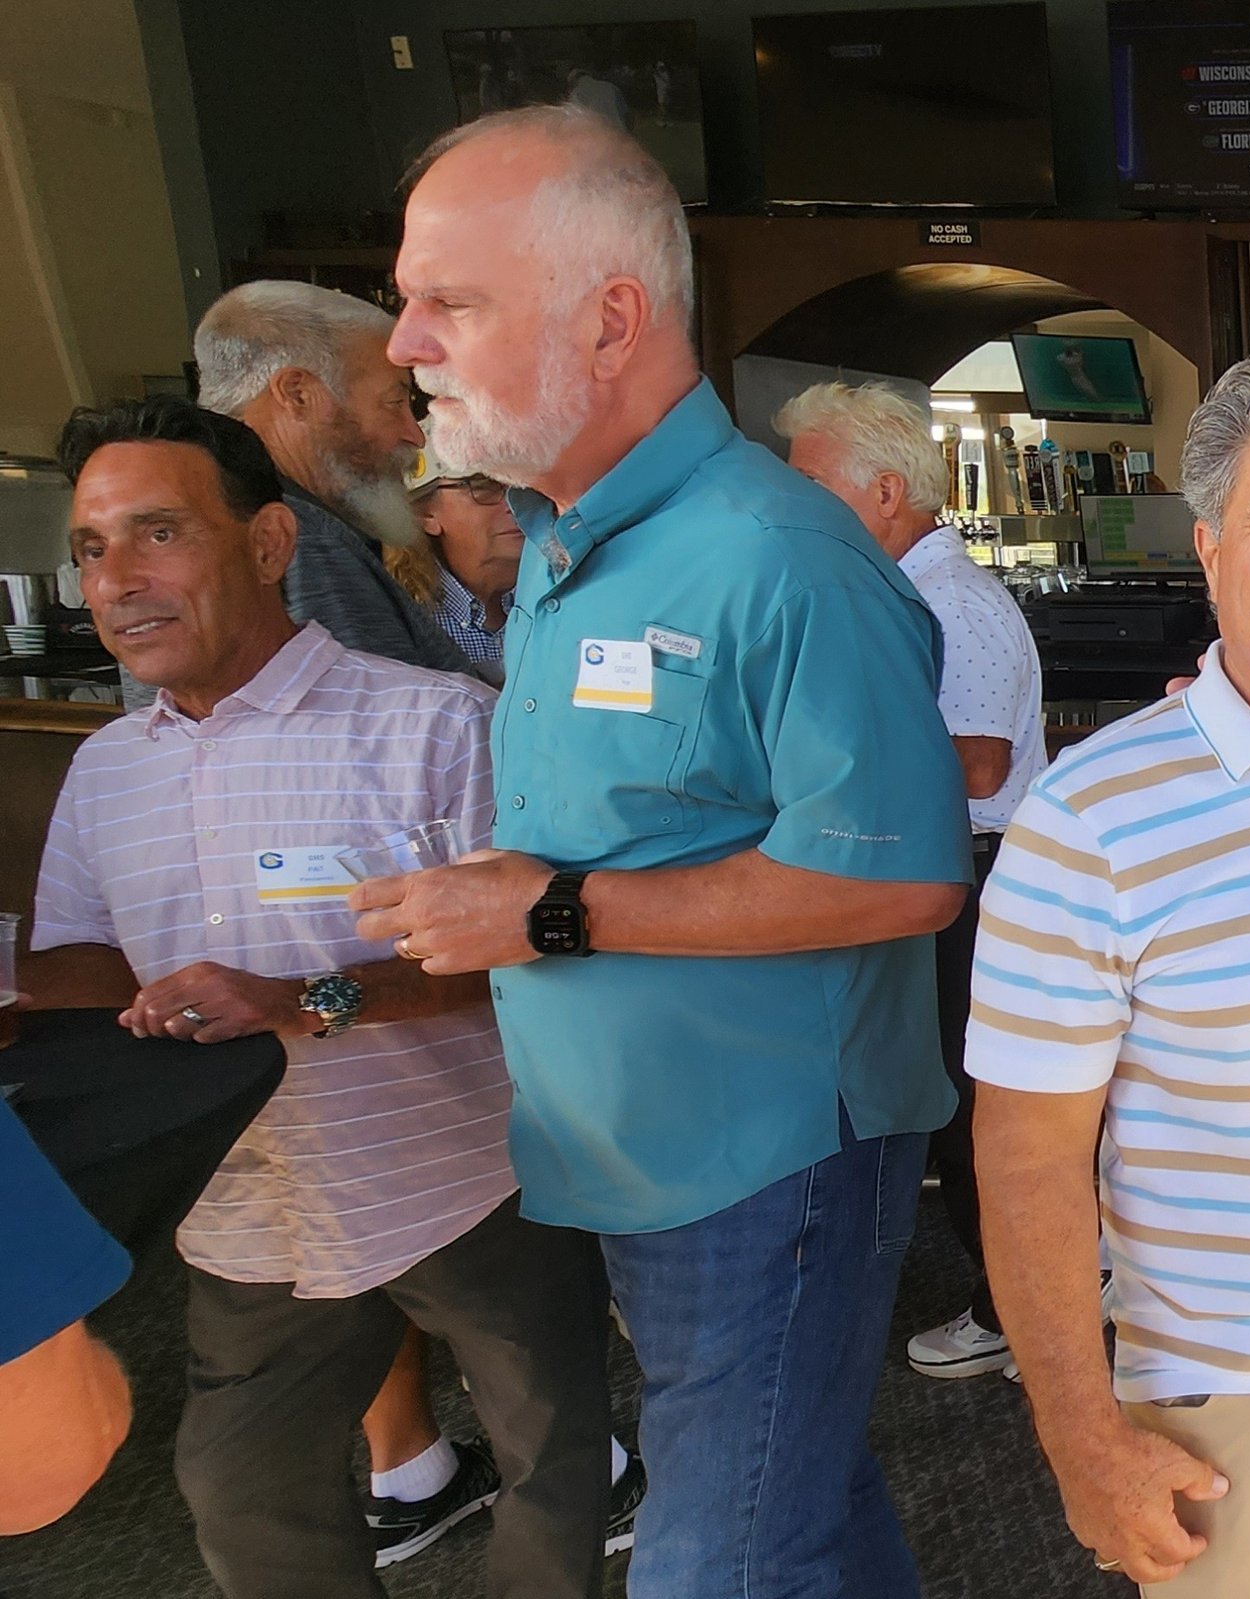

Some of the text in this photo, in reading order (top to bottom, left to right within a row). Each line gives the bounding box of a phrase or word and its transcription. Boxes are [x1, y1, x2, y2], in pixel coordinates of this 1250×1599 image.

[930, 224, 968, 233] NO CASH
[928, 235, 973, 244] ACCEPTED
[659, 634, 693, 651] Columbia
